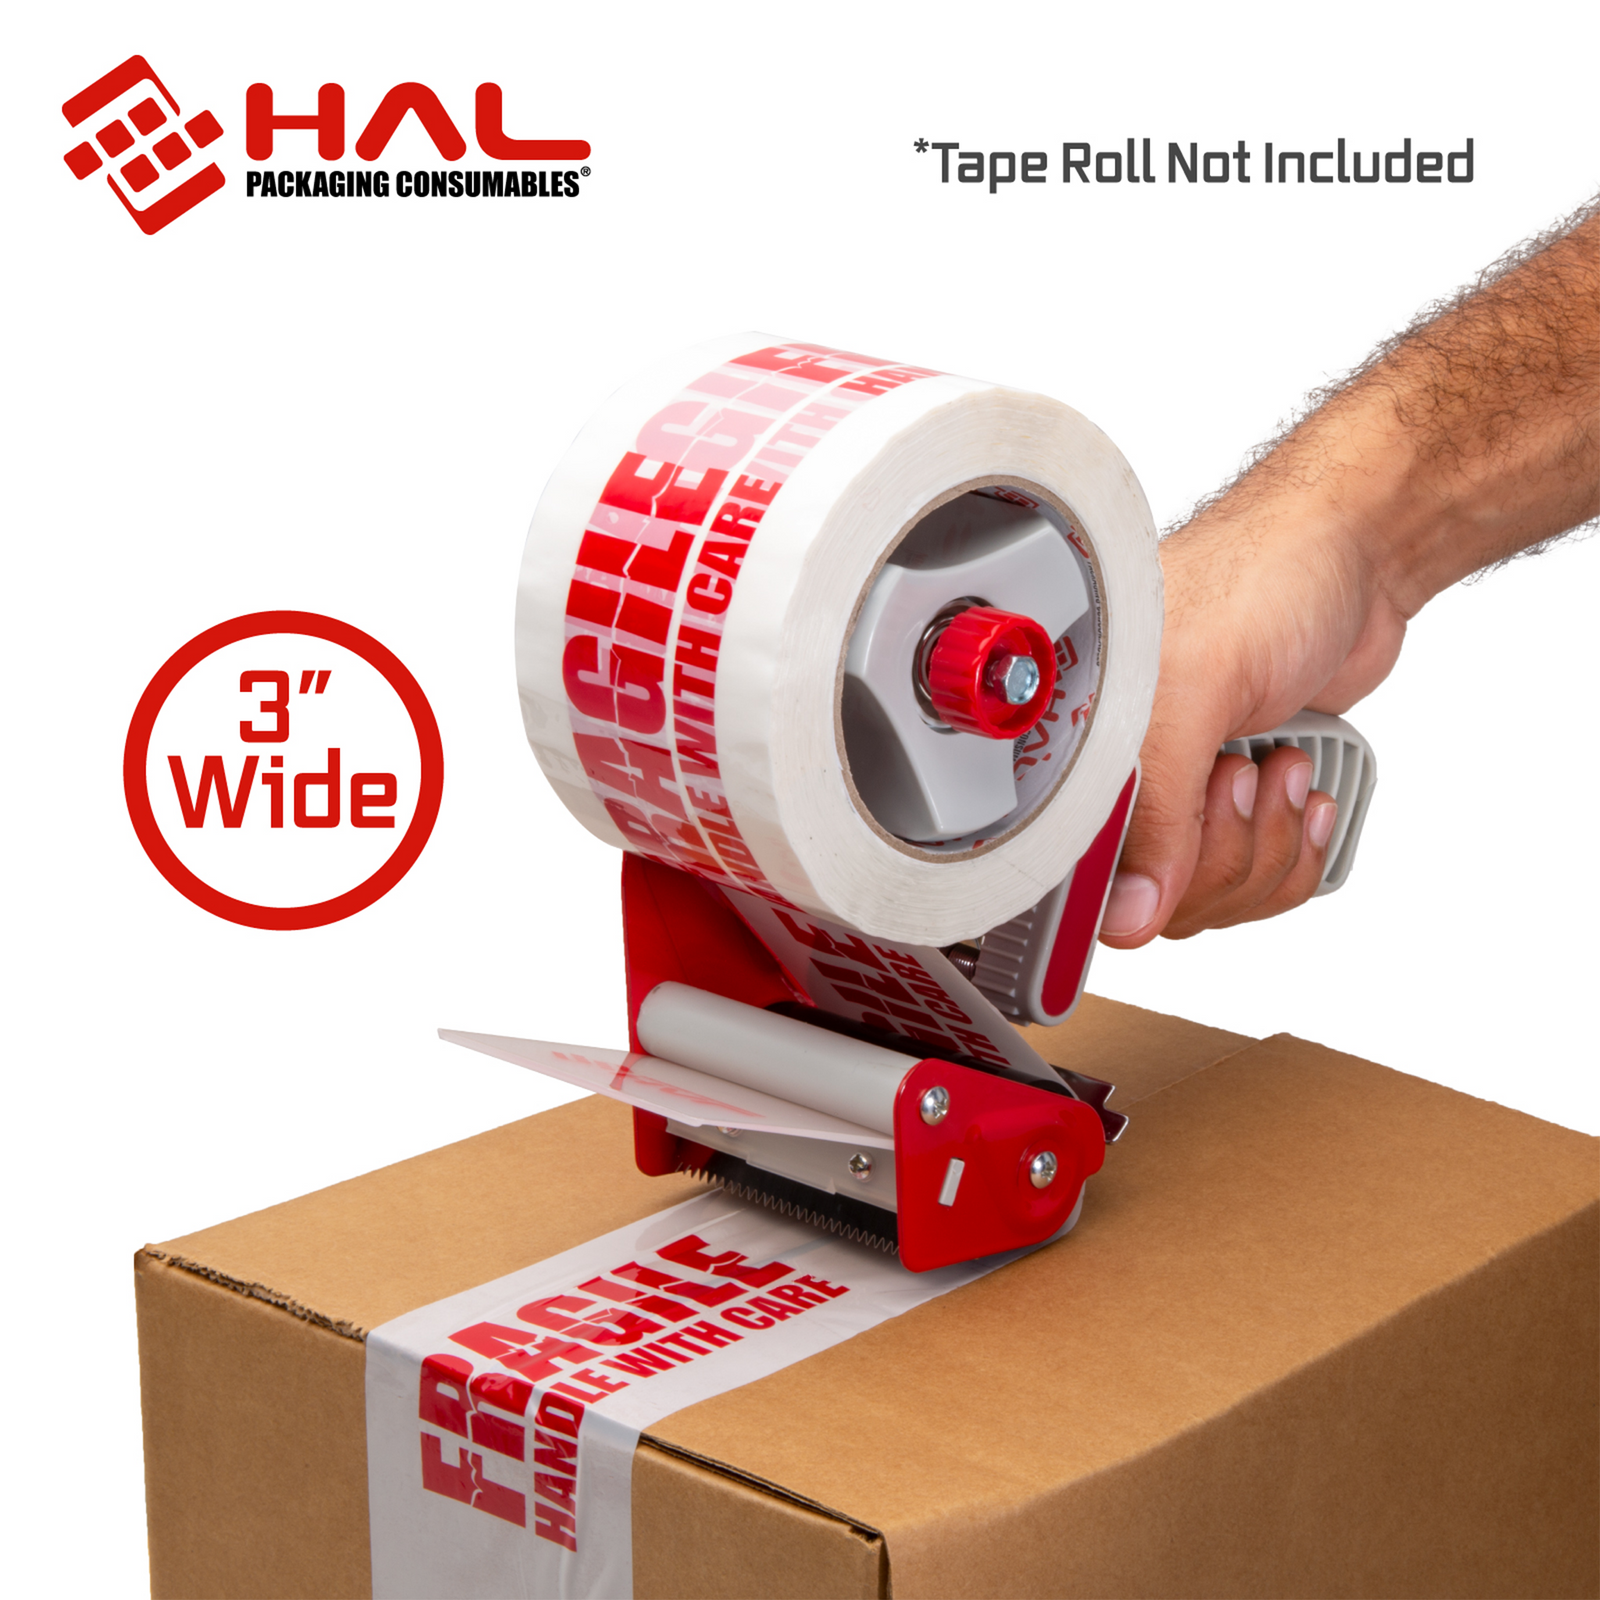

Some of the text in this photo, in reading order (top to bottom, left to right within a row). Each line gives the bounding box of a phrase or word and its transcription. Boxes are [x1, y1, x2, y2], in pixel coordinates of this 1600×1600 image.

[685, 474, 782, 616] CARE
[672, 626, 723, 780] WITH
[871, 943, 974, 1026] CARE
[419, 1234, 796, 1529] FRAGILE
[534, 1273, 851, 1553] HANDLE WITH CARE
